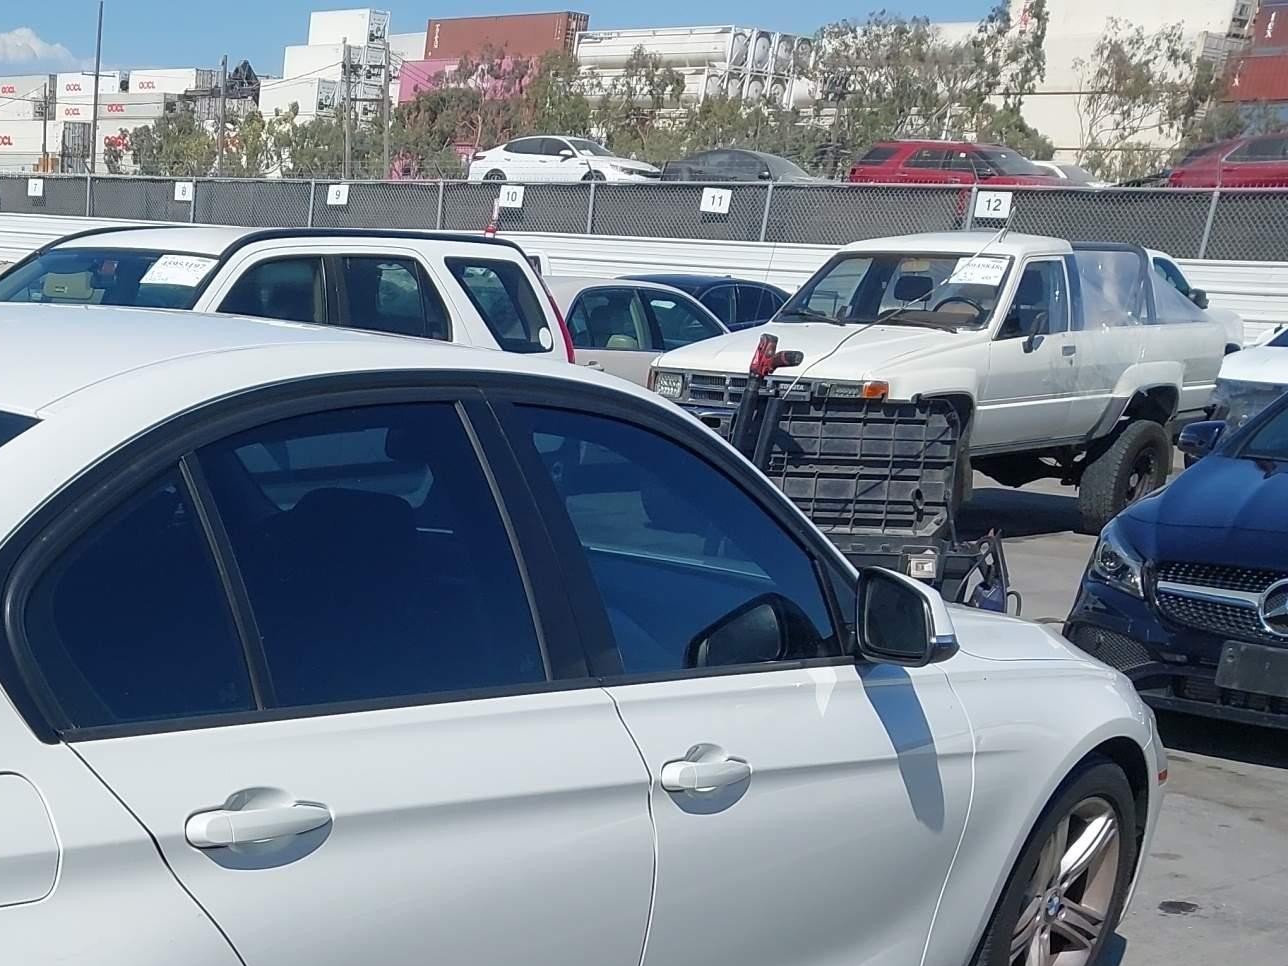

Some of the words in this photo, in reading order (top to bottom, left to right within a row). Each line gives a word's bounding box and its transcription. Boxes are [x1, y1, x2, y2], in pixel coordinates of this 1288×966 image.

[335, 189, 341, 200] 9
[507, 191, 517, 202] 10
[712, 194, 723, 207] 11
[985, 198, 1002, 212] 12
